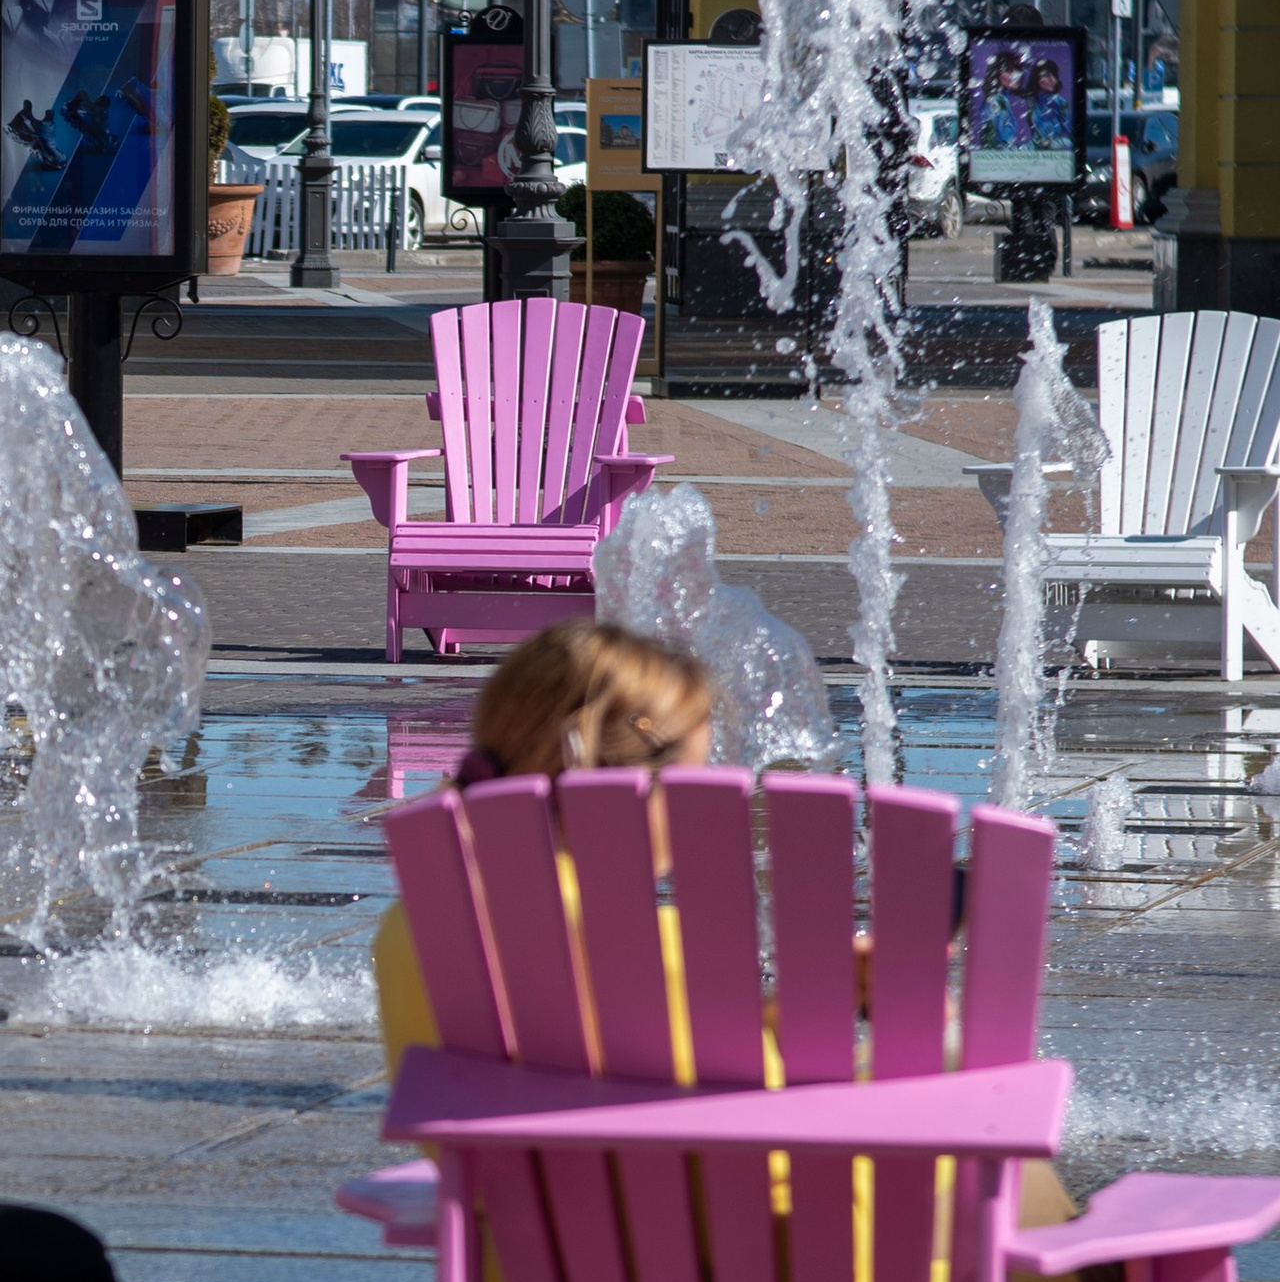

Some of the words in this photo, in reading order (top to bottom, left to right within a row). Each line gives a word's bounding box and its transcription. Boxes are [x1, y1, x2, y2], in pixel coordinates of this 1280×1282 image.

[61, 22, 119, 31] salomon
[12, 205, 71, 215] ФИРМЕННЫЙ
[74, 207, 118, 215] МАГАЗИН
[19, 218, 47, 226] ОБУВЬ
[49, 219, 67, 227] ДЛЯ
[69, 218, 105, 227] СПОРТА
